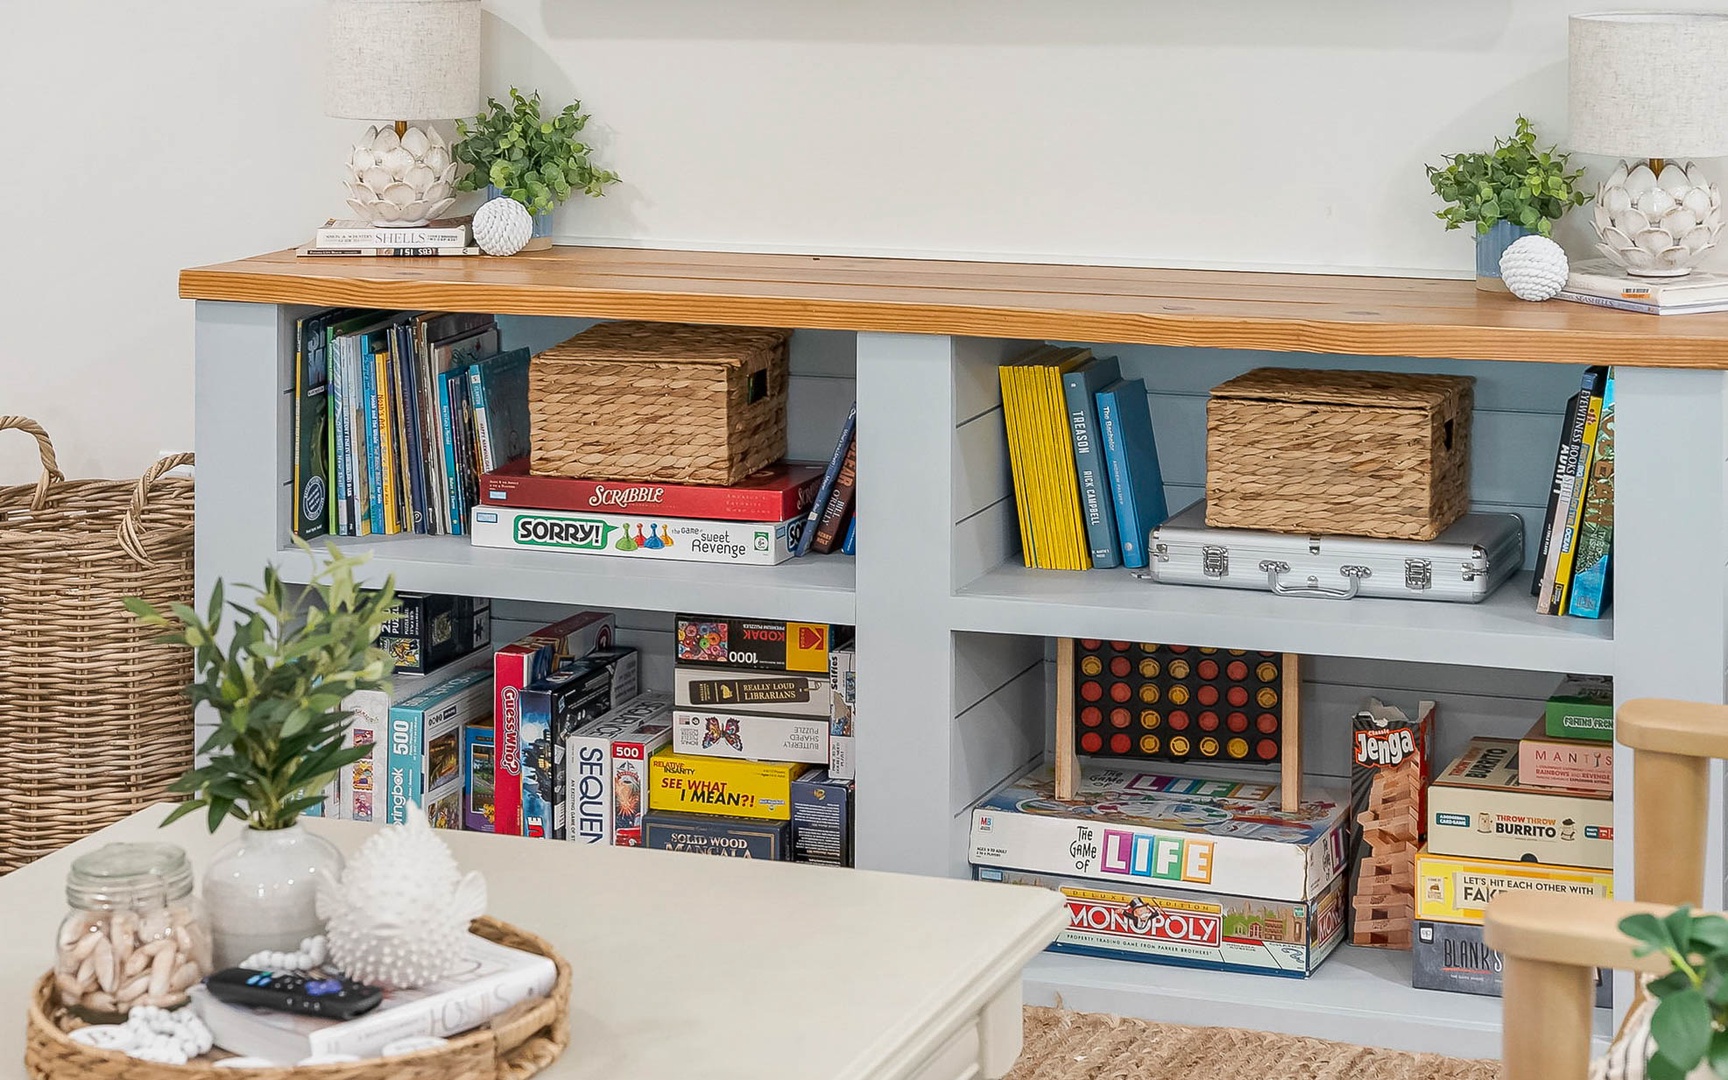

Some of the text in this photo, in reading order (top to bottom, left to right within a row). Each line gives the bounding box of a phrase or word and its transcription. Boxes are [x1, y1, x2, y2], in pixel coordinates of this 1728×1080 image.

[375, 232, 426, 244] SHELLS
[377, 394, 385, 417] Noah's
[1102, 406, 1110, 420] The
[1072, 410, 1090, 454] TREASON
[1565, 390, 1591, 475] EYEWITNESS BOOKS
[589, 485, 665, 507] SCRABBLE
[1083, 470, 1100, 526] RICK CAMPBELL
[833, 500, 844, 517] BILL
[518, 520, 601, 544] SORRY!
[700, 530, 730, 544] sweet
[1561, 527, 1573, 553] OCEAN
[691, 539, 746, 558] Revenge
[743, 630, 785, 641] KODAK
[729, 651, 758, 664] 1000
[743, 683, 770, 692] REALLY
[744, 689, 796, 700] LIBRARIANS
[393, 720, 409, 756] 500
[789, 734, 819, 742] SHAPED
[794, 727, 819, 735] PUZZLE
[615, 746, 639, 758] 500
[783, 741, 819, 750] BUTTERFLY
[1357, 730, 1414, 765] Jenga
[653, 761, 685, 769] RELATIVE
[664, 767, 695, 775] INSANITY
[1536, 768, 1570, 776] RAINBOWS
[661, 777, 727, 794] SEE WHAT
[1132, 775, 1265, 799] LIFE
[391, 767, 408, 825] ringbok
[579, 747, 604, 844] SEQUEN
[680, 789, 686, 801] I
[691, 791, 755, 808] MEAN?!
[1496, 814, 1556, 825] THROW THROW
[1496, 822, 1556, 838] BURRITO
[671, 833, 748, 849] SOLID WOOD
[1103, 829, 1214, 884] LIFE
[1464, 876, 1594, 895] LET'S HIT EACH OTHER WITH
[1072, 890, 1209, 911] DELUXE EDITION
[1067, 903, 1216, 941] MONOPOLY
[1066, 934, 1094, 942] PROPERTY
[1096, 937, 1120, 945] TRADING
[1444, 938, 1490, 972] BLANK
